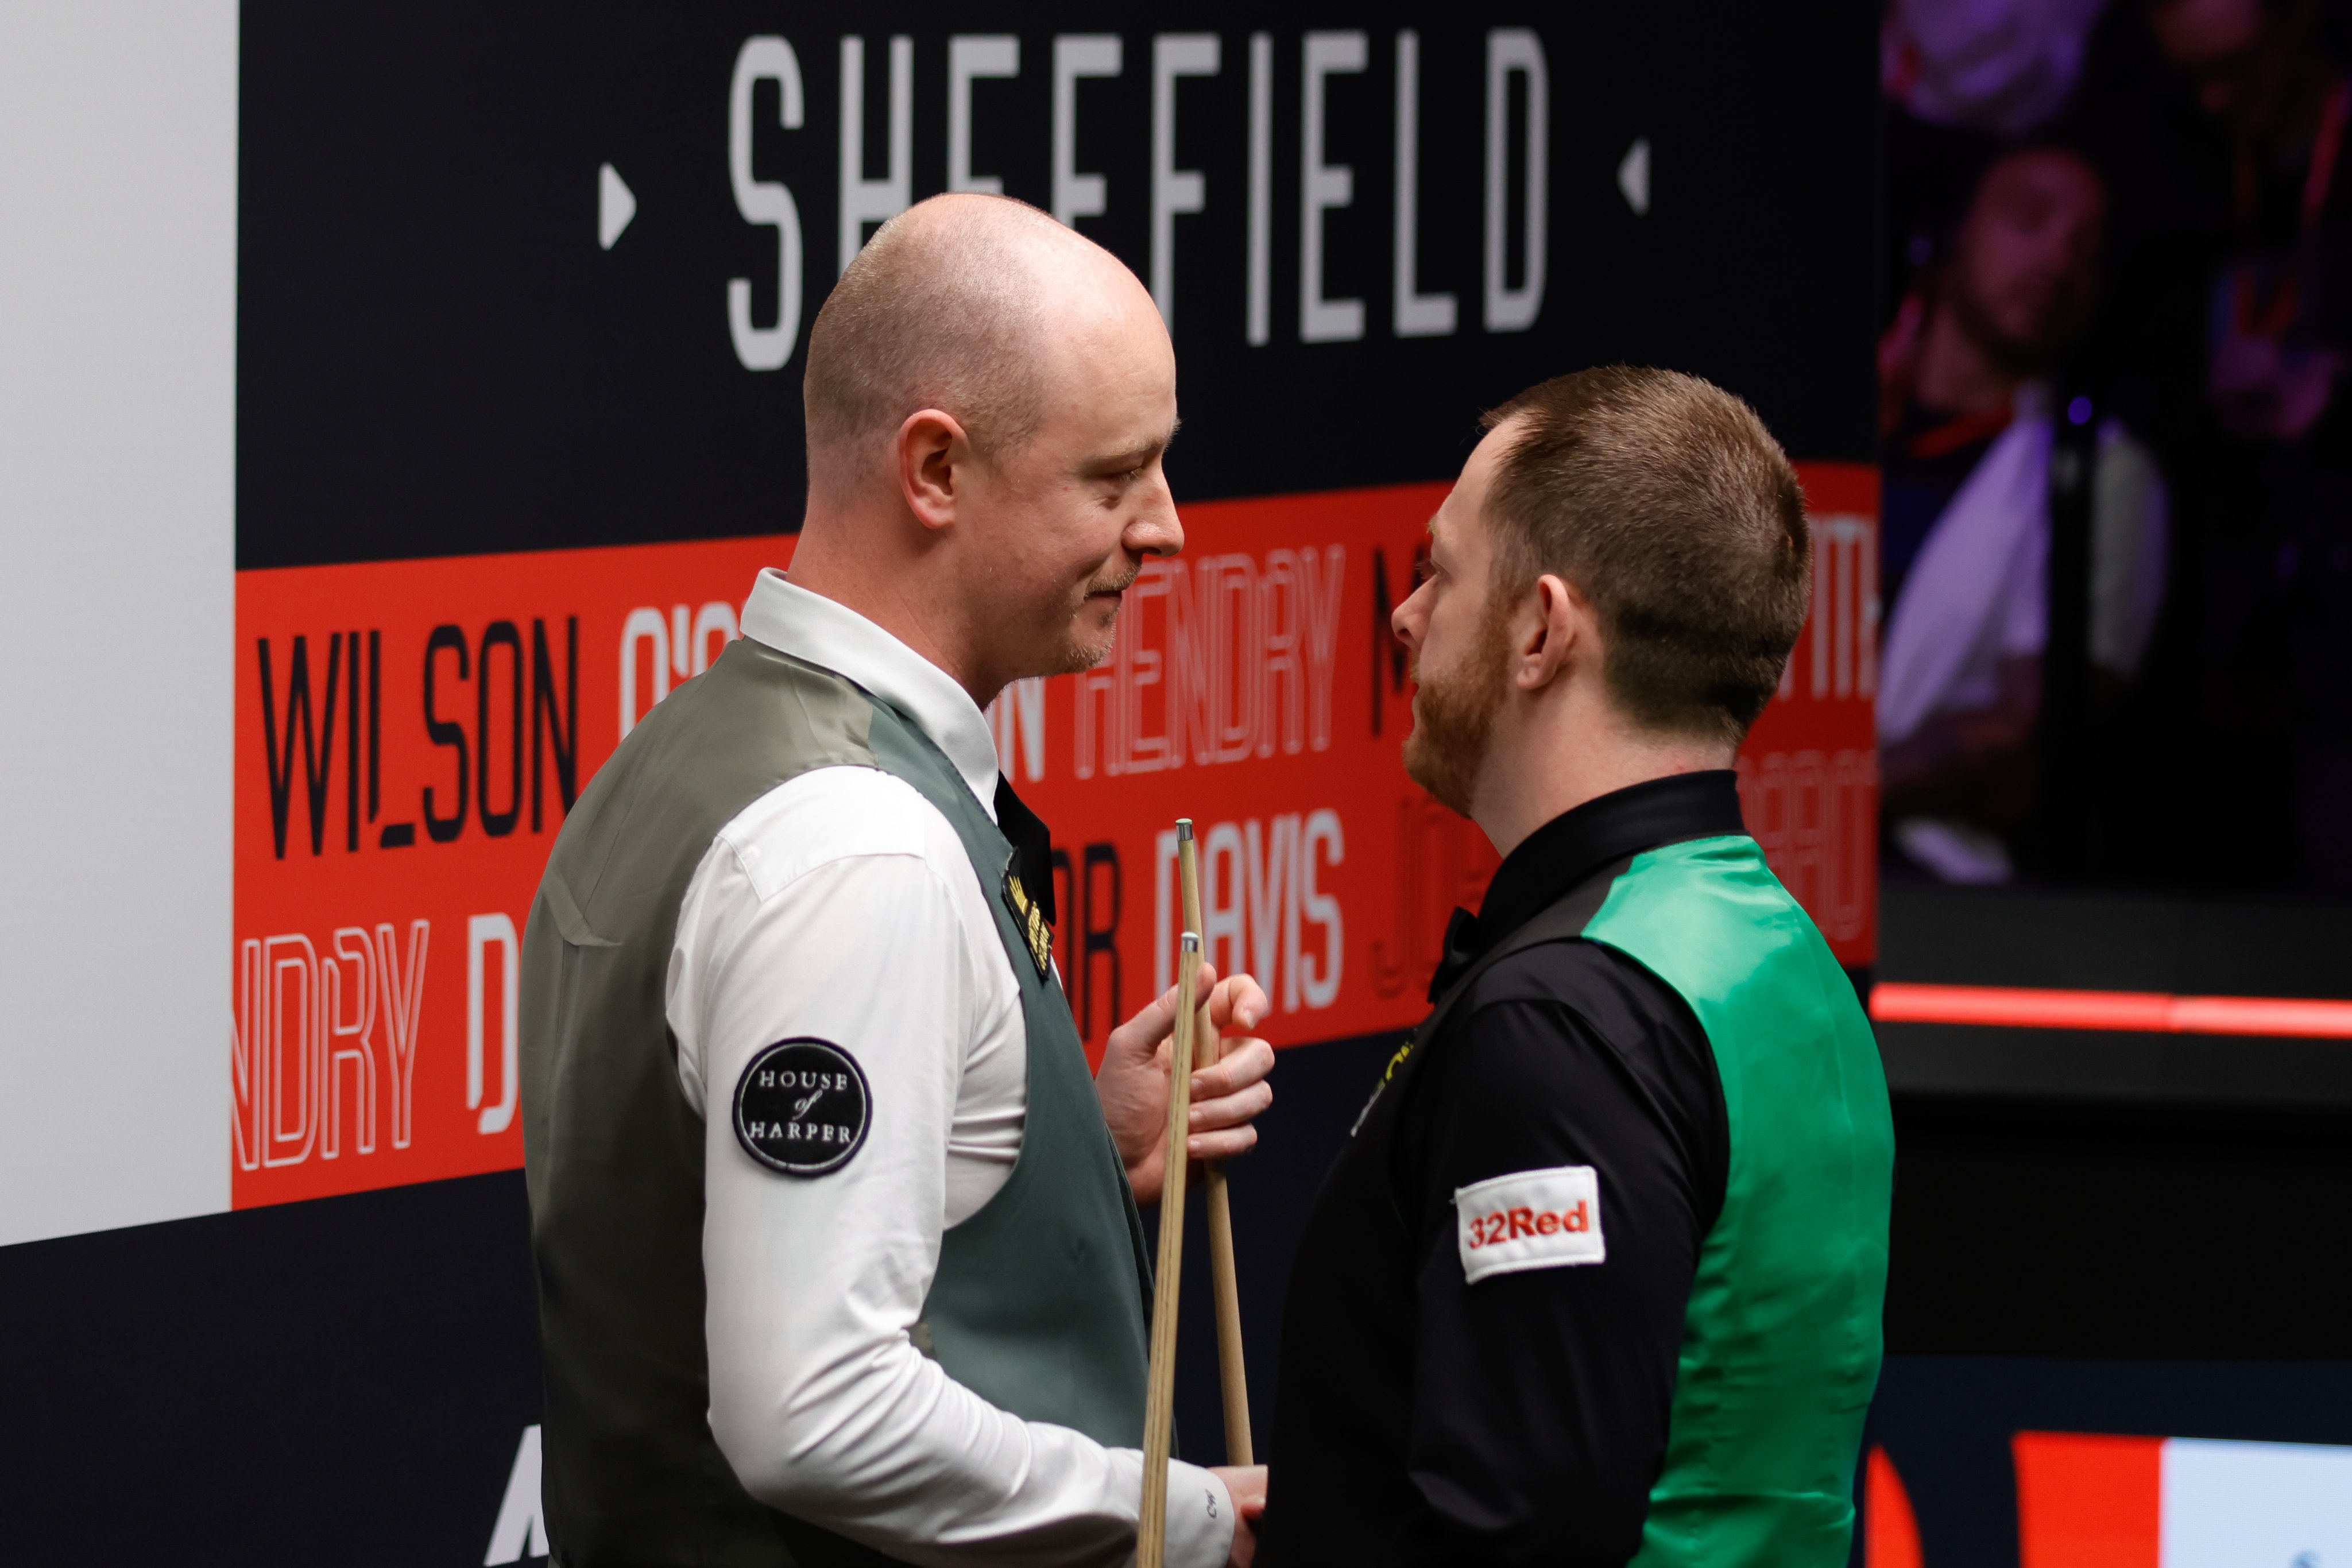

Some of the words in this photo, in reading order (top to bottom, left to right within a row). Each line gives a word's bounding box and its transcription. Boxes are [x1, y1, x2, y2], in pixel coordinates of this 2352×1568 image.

[257, 615, 578, 860] WILSON
[758, 1070, 848, 1091] HOUSE
[792, 1089, 823, 1121] of
[749, 1121, 850, 1144] HARPER
[1468, 1199, 1588, 1249] 32Red
